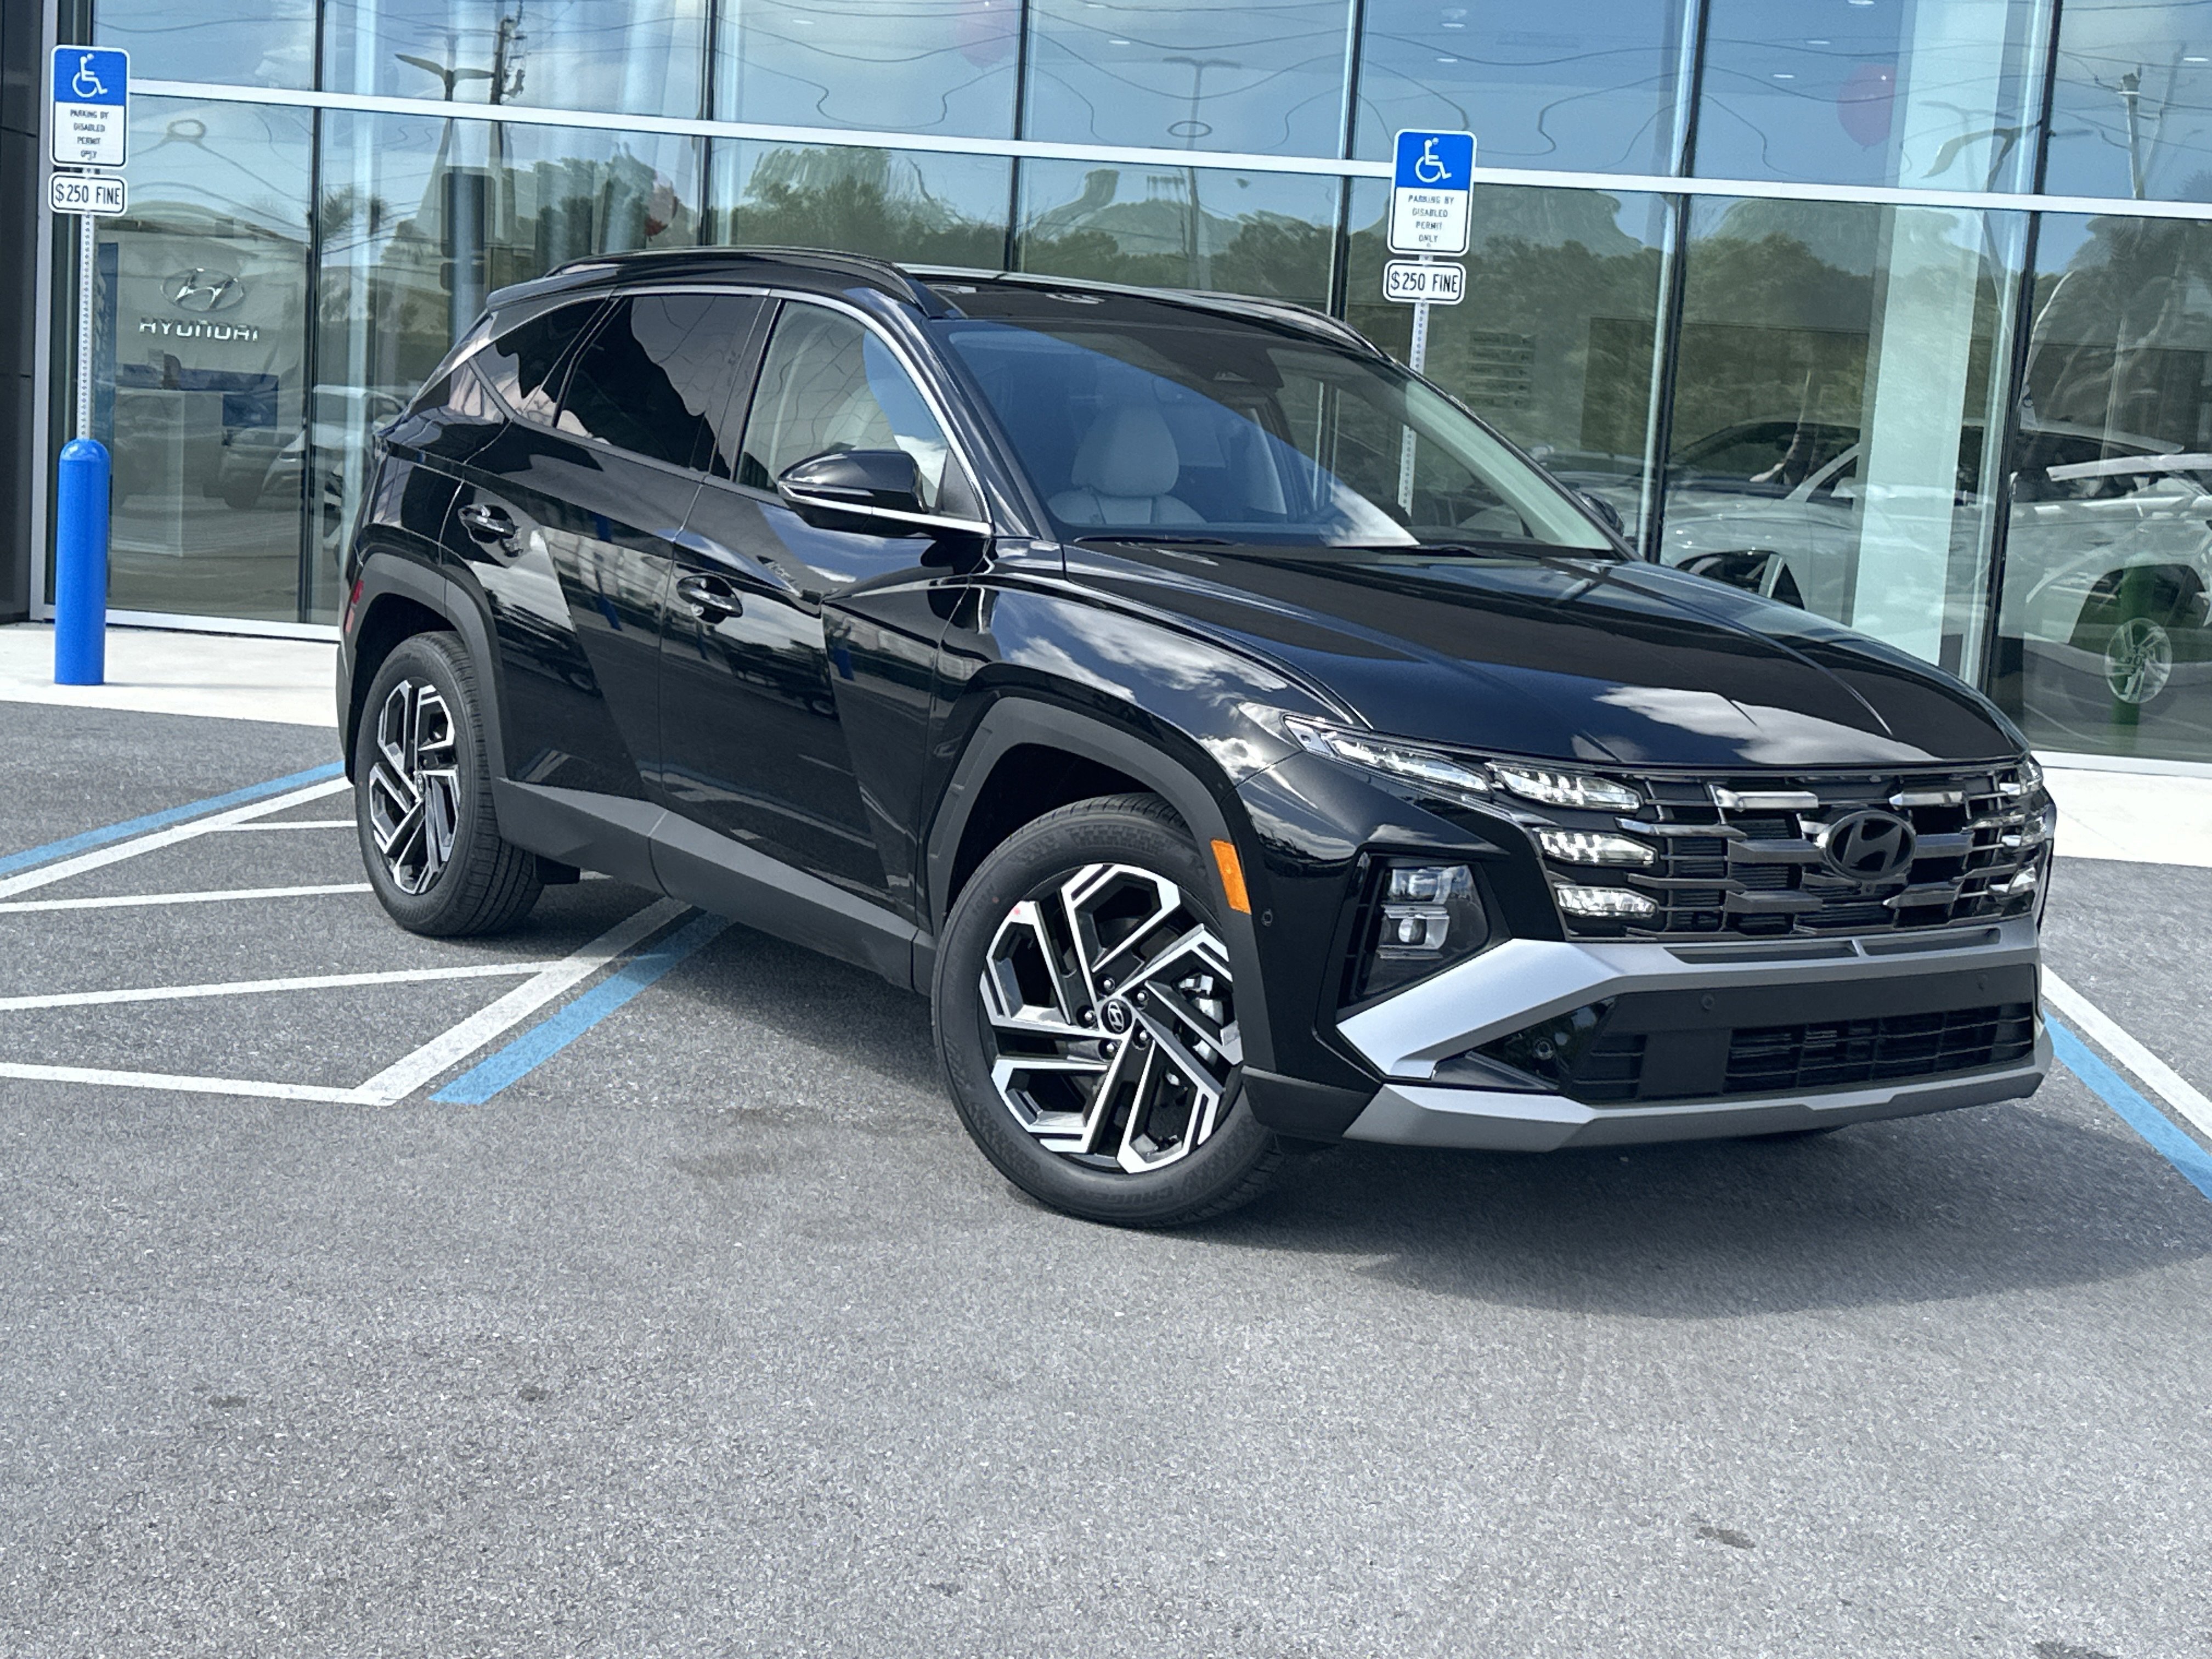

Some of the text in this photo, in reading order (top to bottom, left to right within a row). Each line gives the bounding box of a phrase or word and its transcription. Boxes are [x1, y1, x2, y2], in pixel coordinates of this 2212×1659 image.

[55, 183, 121, 205] $250 FINE
[1408, 195, 1454, 205] PARKING BY
[1413, 207, 1448, 217] DISABLED
[1416, 221, 1442, 230] PERMIT
[1419, 234, 1438, 242] ONLY
[1391, 271, 1458, 292] $250 FINE
[139, 317, 259, 341] HYUNDAI
